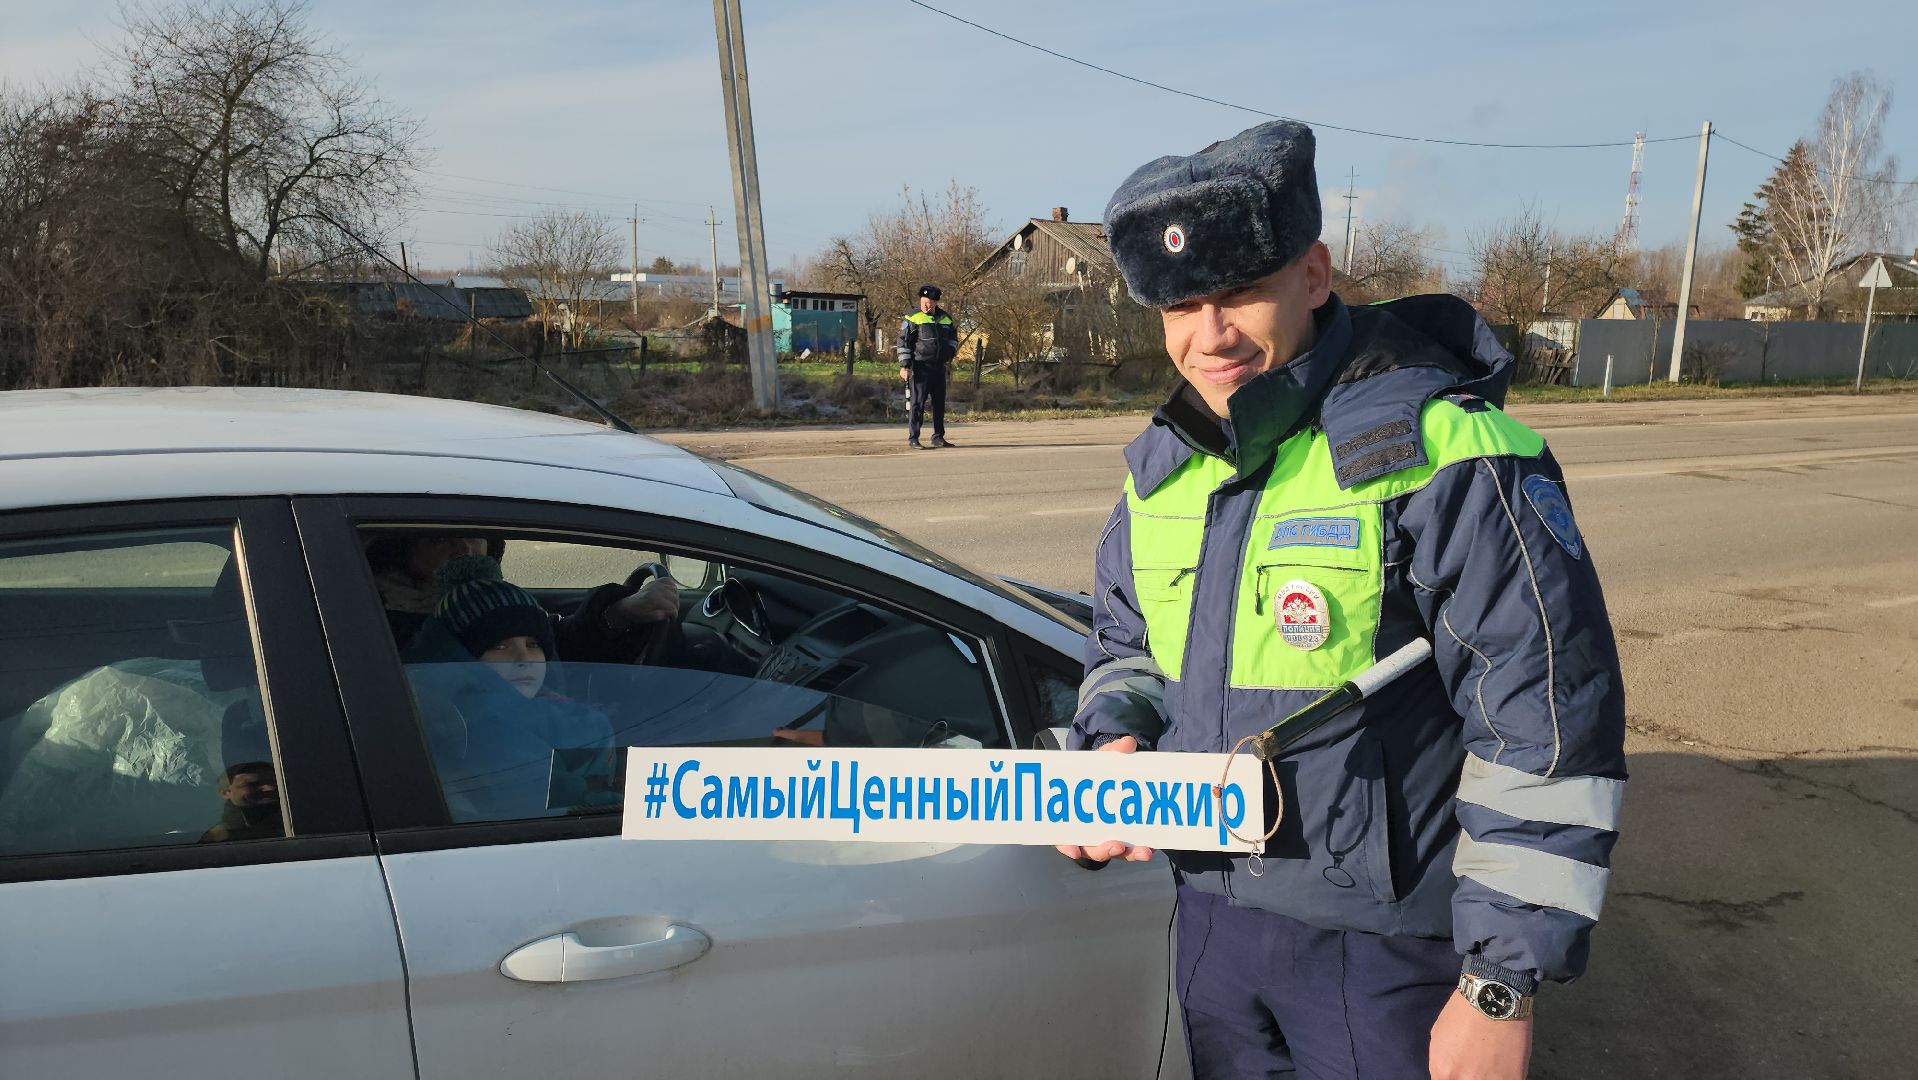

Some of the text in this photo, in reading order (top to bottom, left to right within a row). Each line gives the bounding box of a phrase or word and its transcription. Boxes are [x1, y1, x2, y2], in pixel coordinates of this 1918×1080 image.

[1275, 524, 1351, 541] ДПС ГИБДД
[1282, 625, 1321, 633] ПОЛИЦИЯ
[644, 759, 1245, 845] #СамыйЦенныйПассажир
